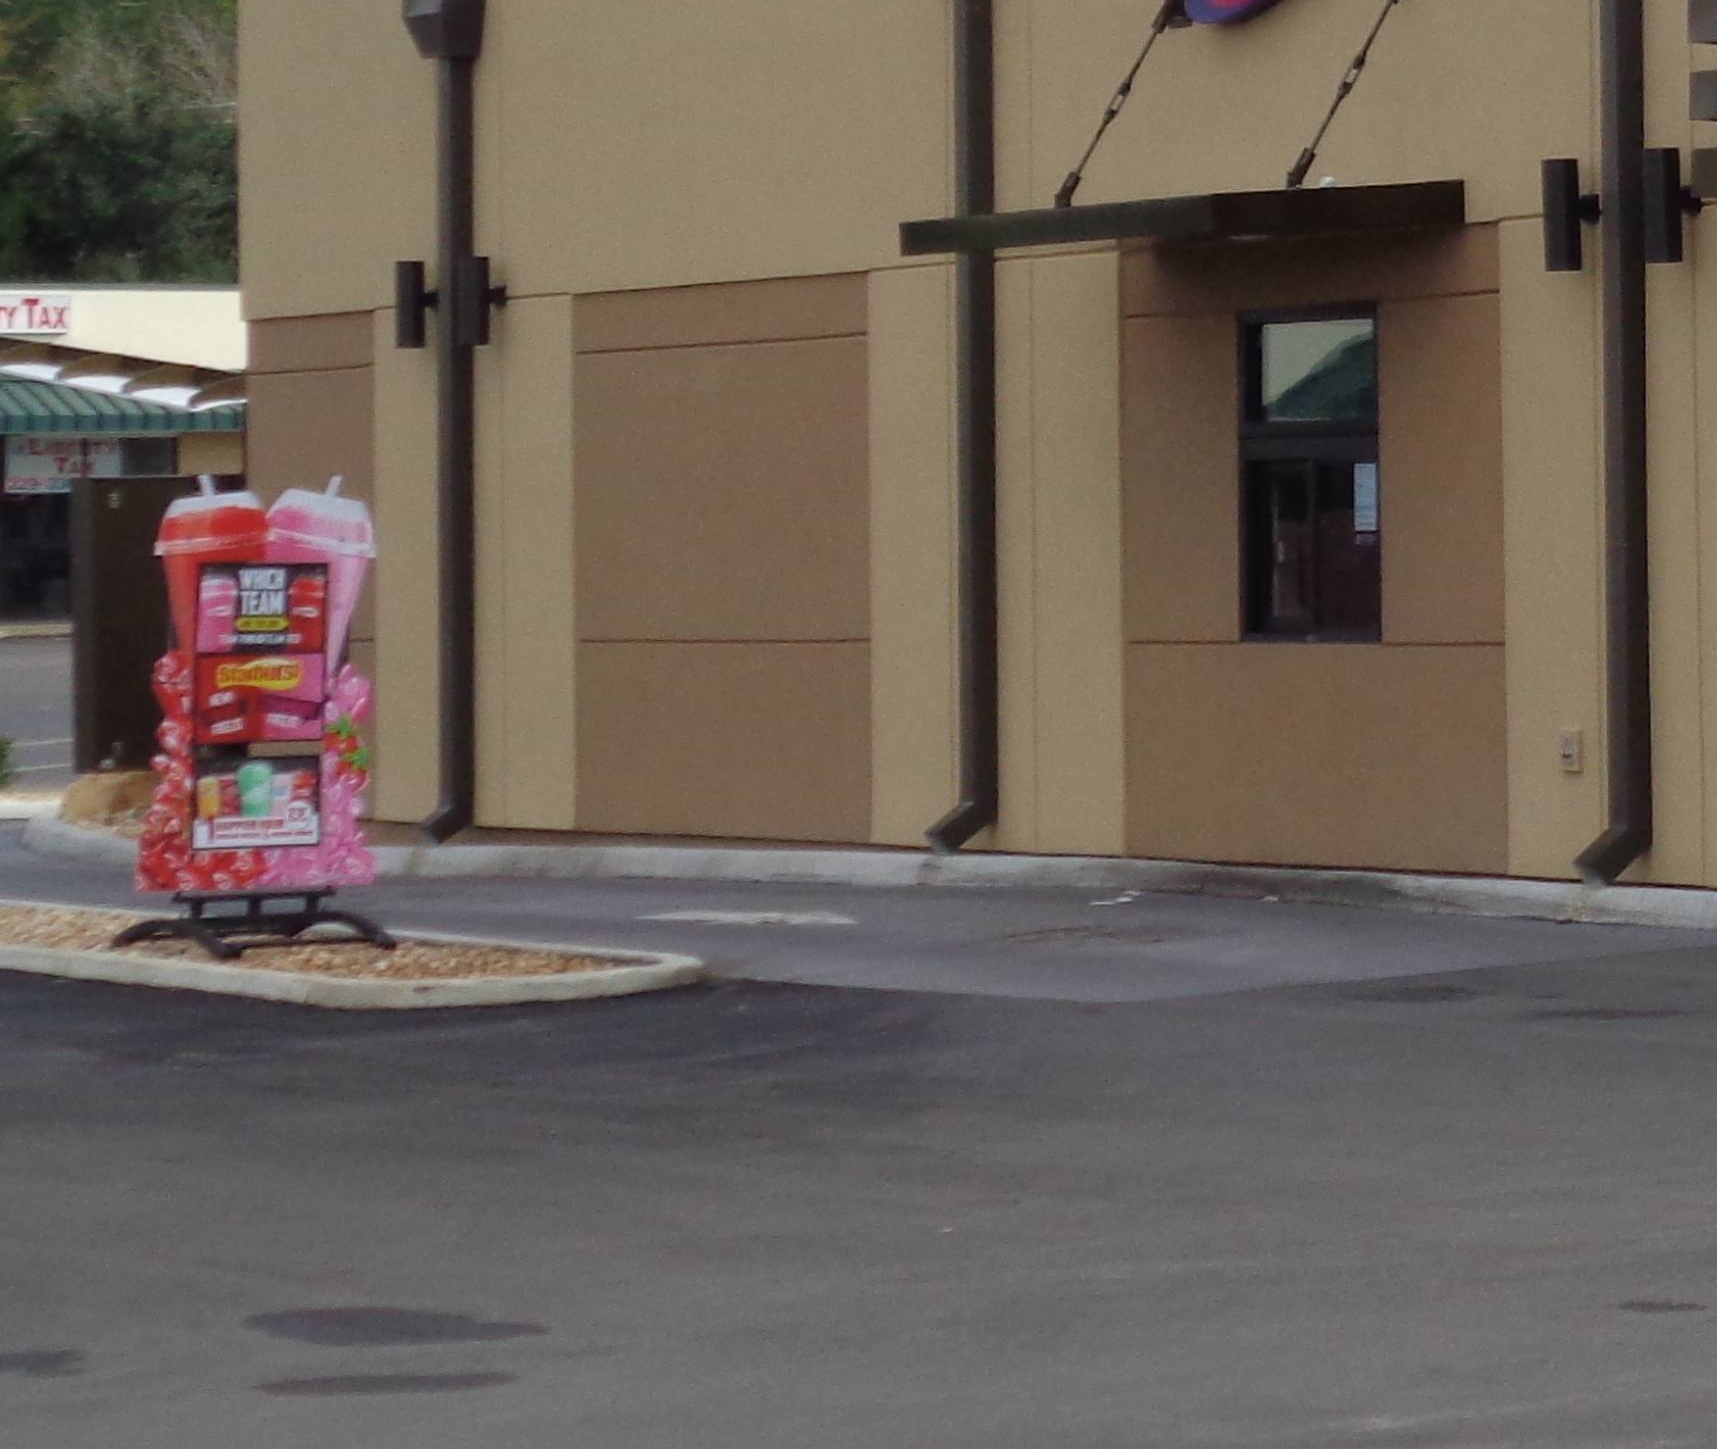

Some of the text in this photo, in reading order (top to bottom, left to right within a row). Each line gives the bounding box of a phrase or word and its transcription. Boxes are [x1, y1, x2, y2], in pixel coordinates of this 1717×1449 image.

[22, 298, 68, 329] TAX
[238, 567, 287, 590] WHICH
[240, 590, 287, 616] TEAM
